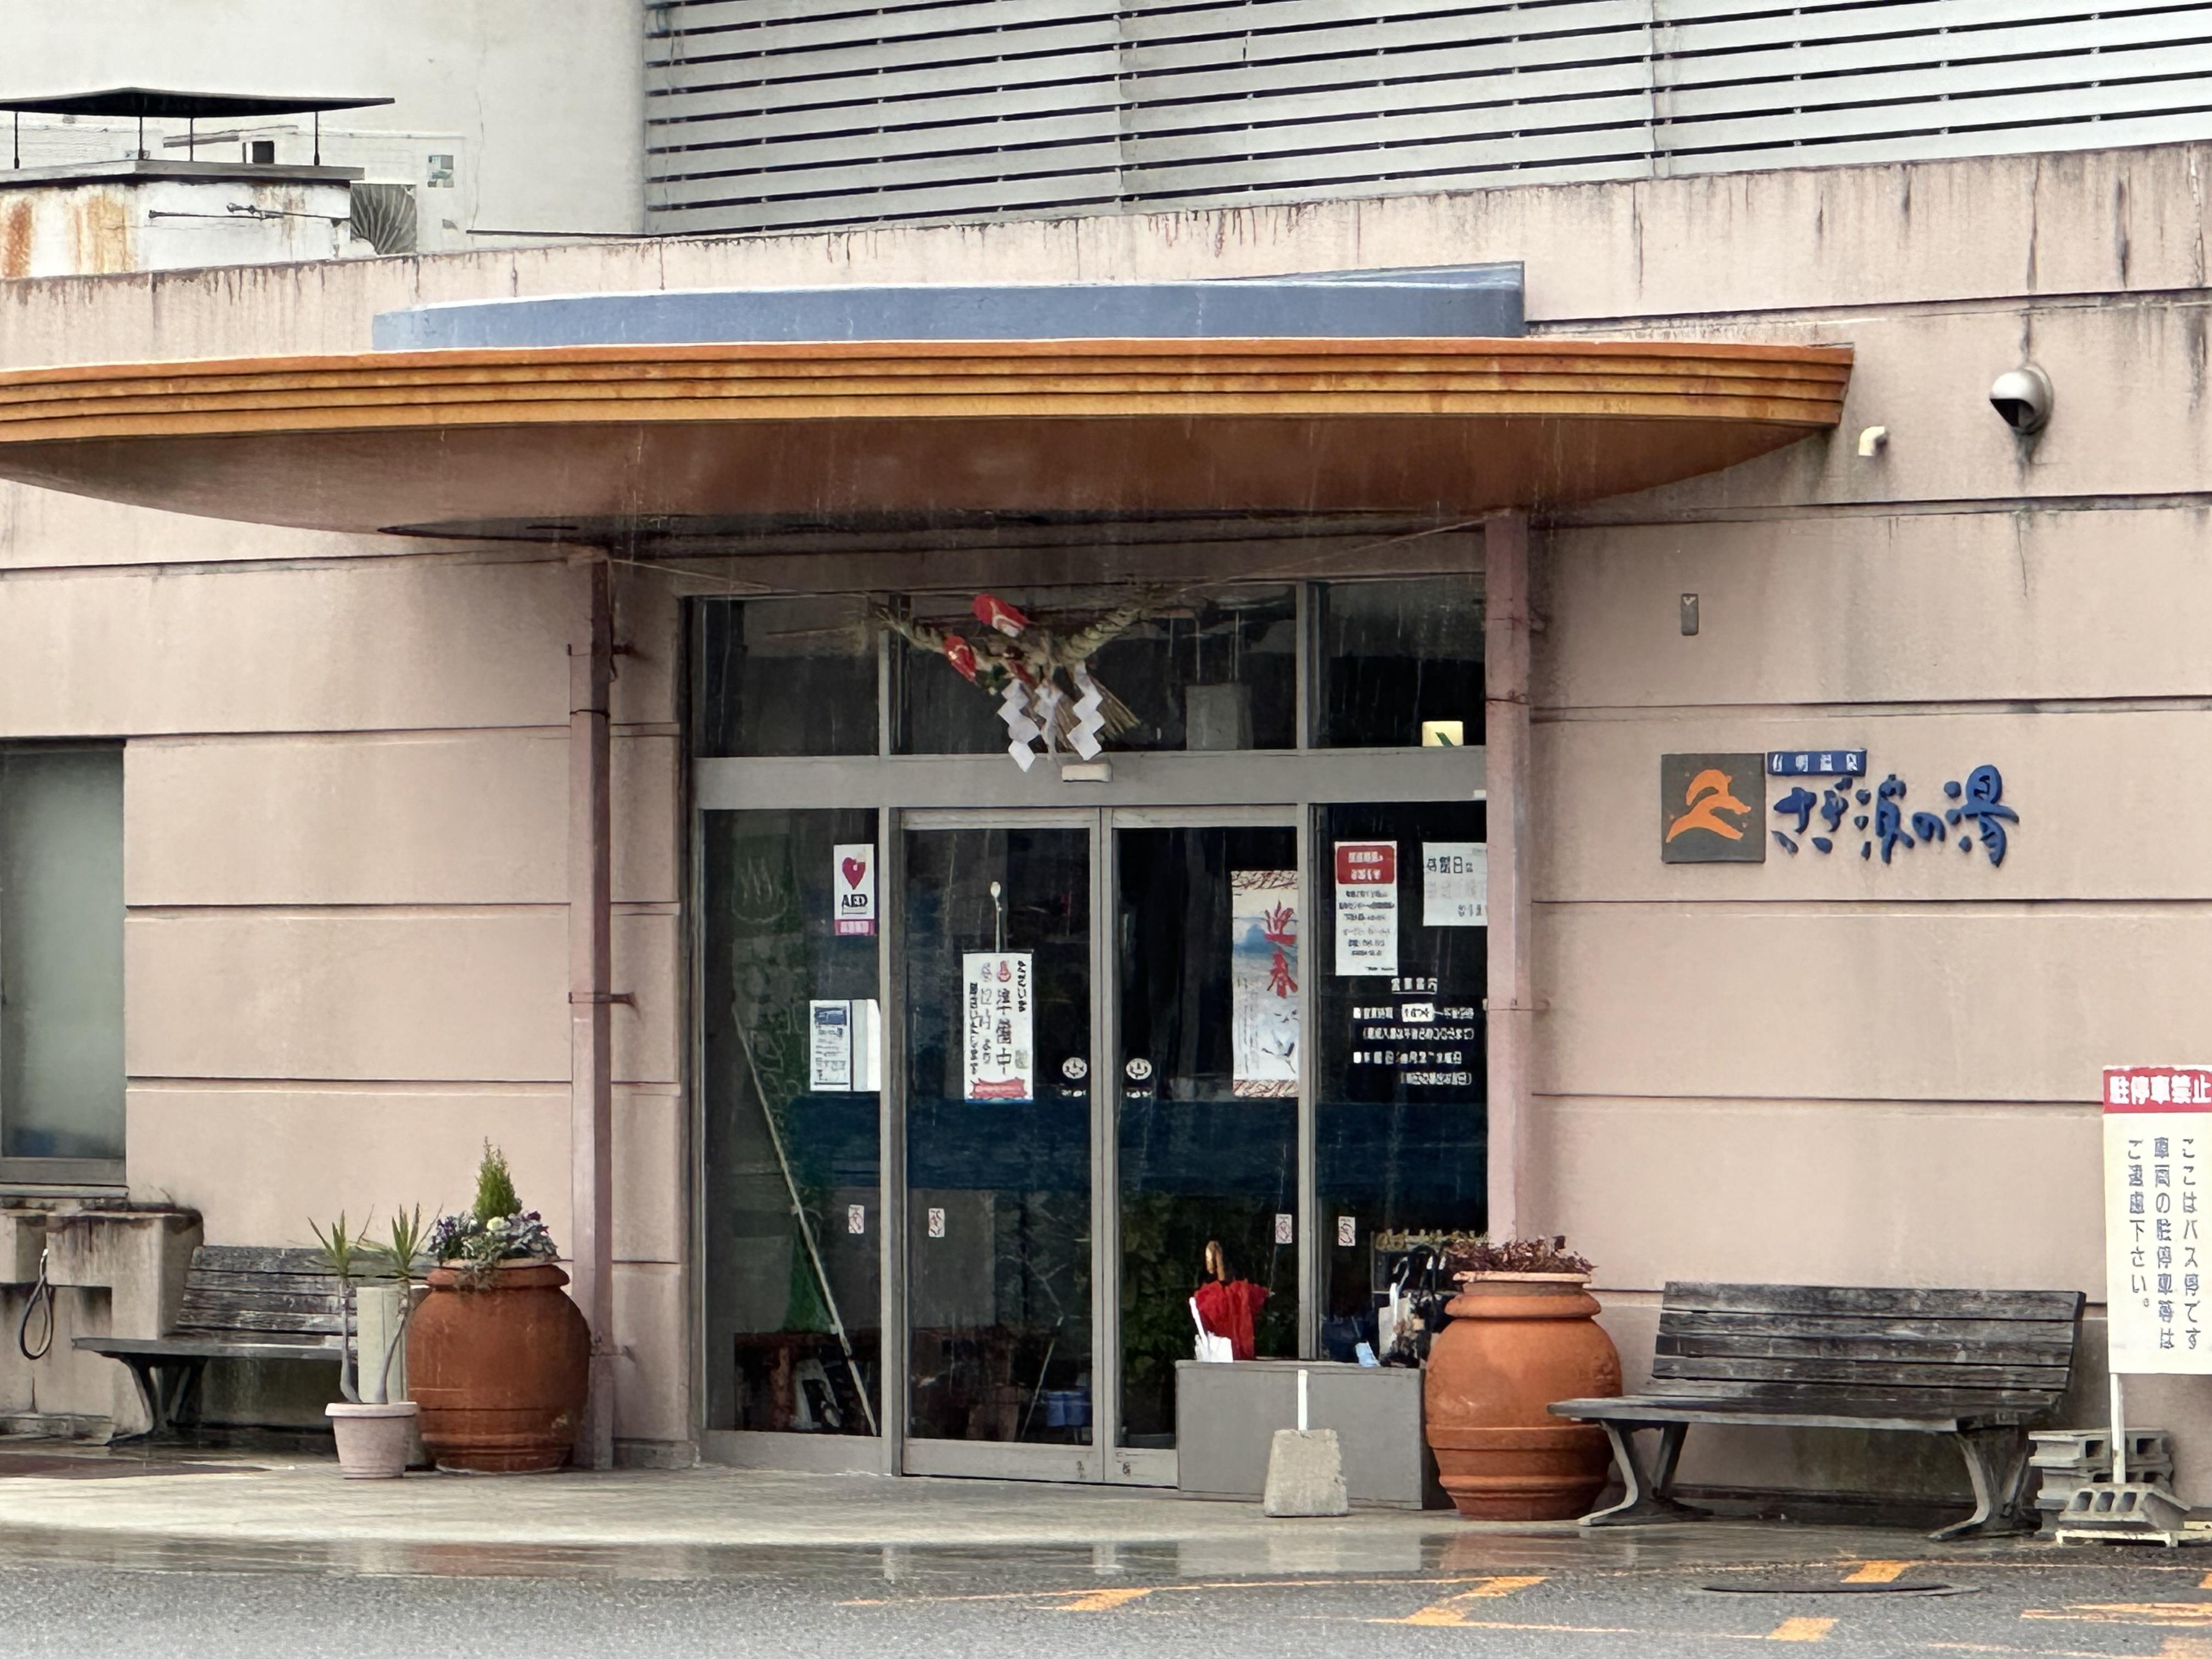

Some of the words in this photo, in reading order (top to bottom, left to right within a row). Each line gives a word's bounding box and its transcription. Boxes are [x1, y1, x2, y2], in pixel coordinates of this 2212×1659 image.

[842, 894, 868, 907] AED
[2109, 1074, 2211, 1105] 駐停車禁止
[2154, 1137, 2175, 1349] 車両の駐停車等は
[2182, 1138, 2202, 1350] ここはバス停です
